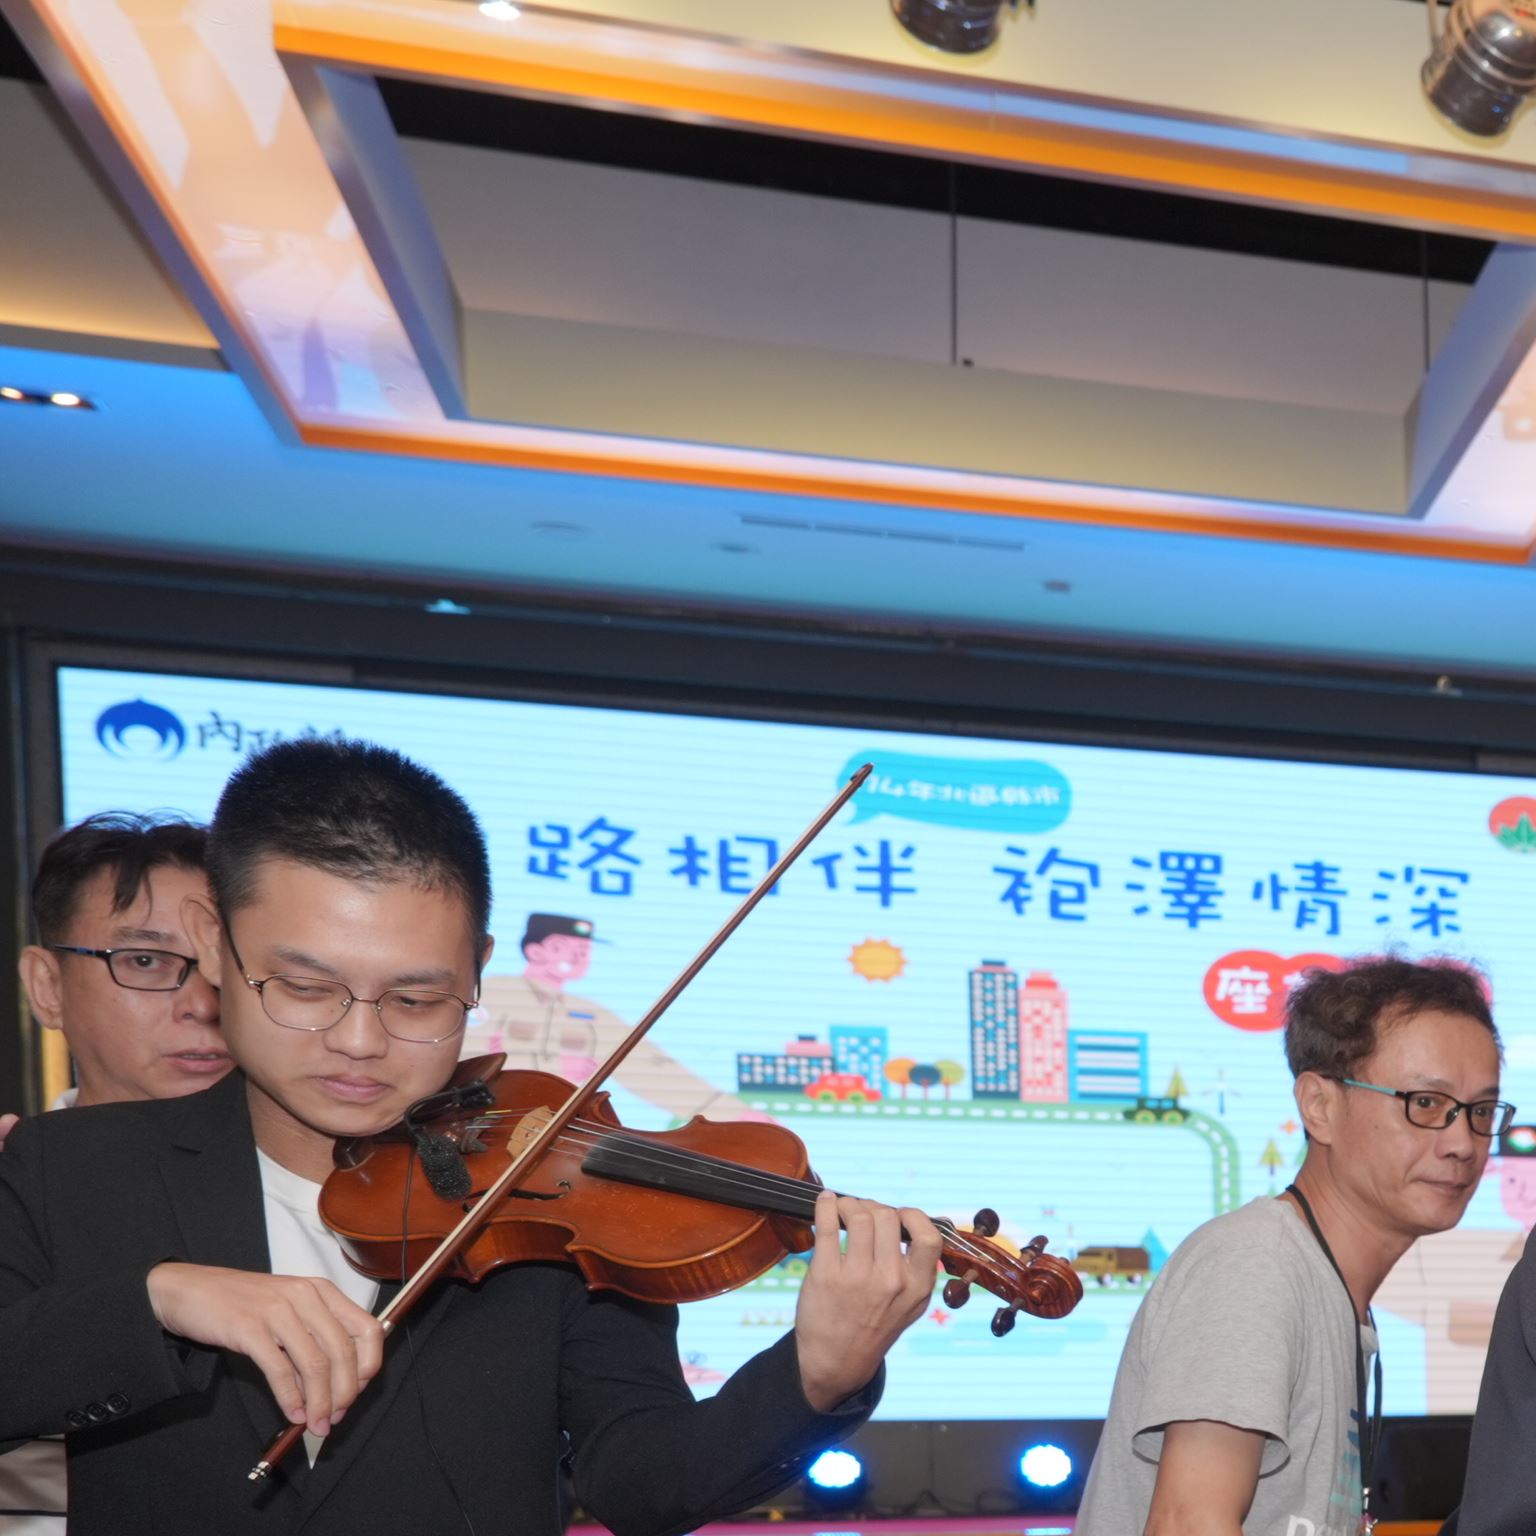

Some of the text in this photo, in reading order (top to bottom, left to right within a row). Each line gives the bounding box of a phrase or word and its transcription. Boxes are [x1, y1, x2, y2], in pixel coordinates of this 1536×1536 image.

[526, 816, 1472, 938] 路相伴 袍澤情深
